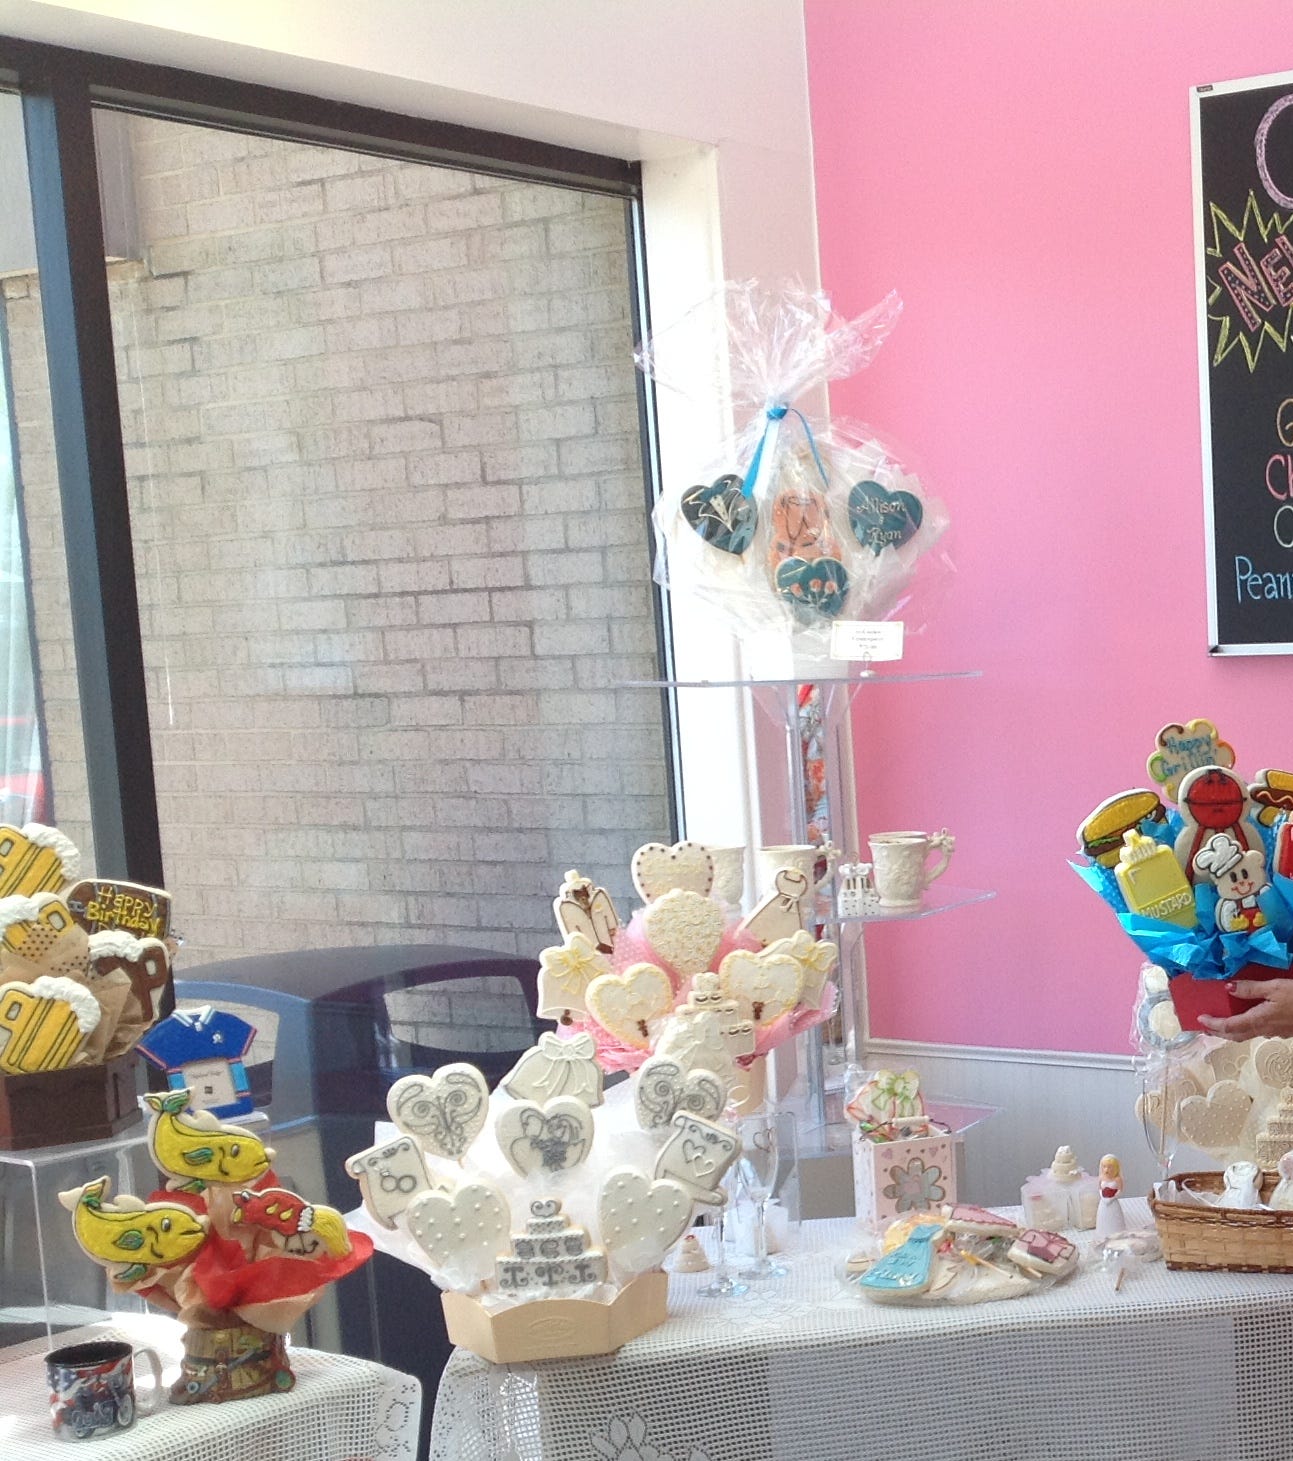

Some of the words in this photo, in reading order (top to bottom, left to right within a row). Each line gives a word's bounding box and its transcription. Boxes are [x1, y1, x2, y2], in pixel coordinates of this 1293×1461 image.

[867, 527, 903, 548] Ryan
[98, 885, 158, 918] Happy
[86, 901, 161, 937] Birthday
